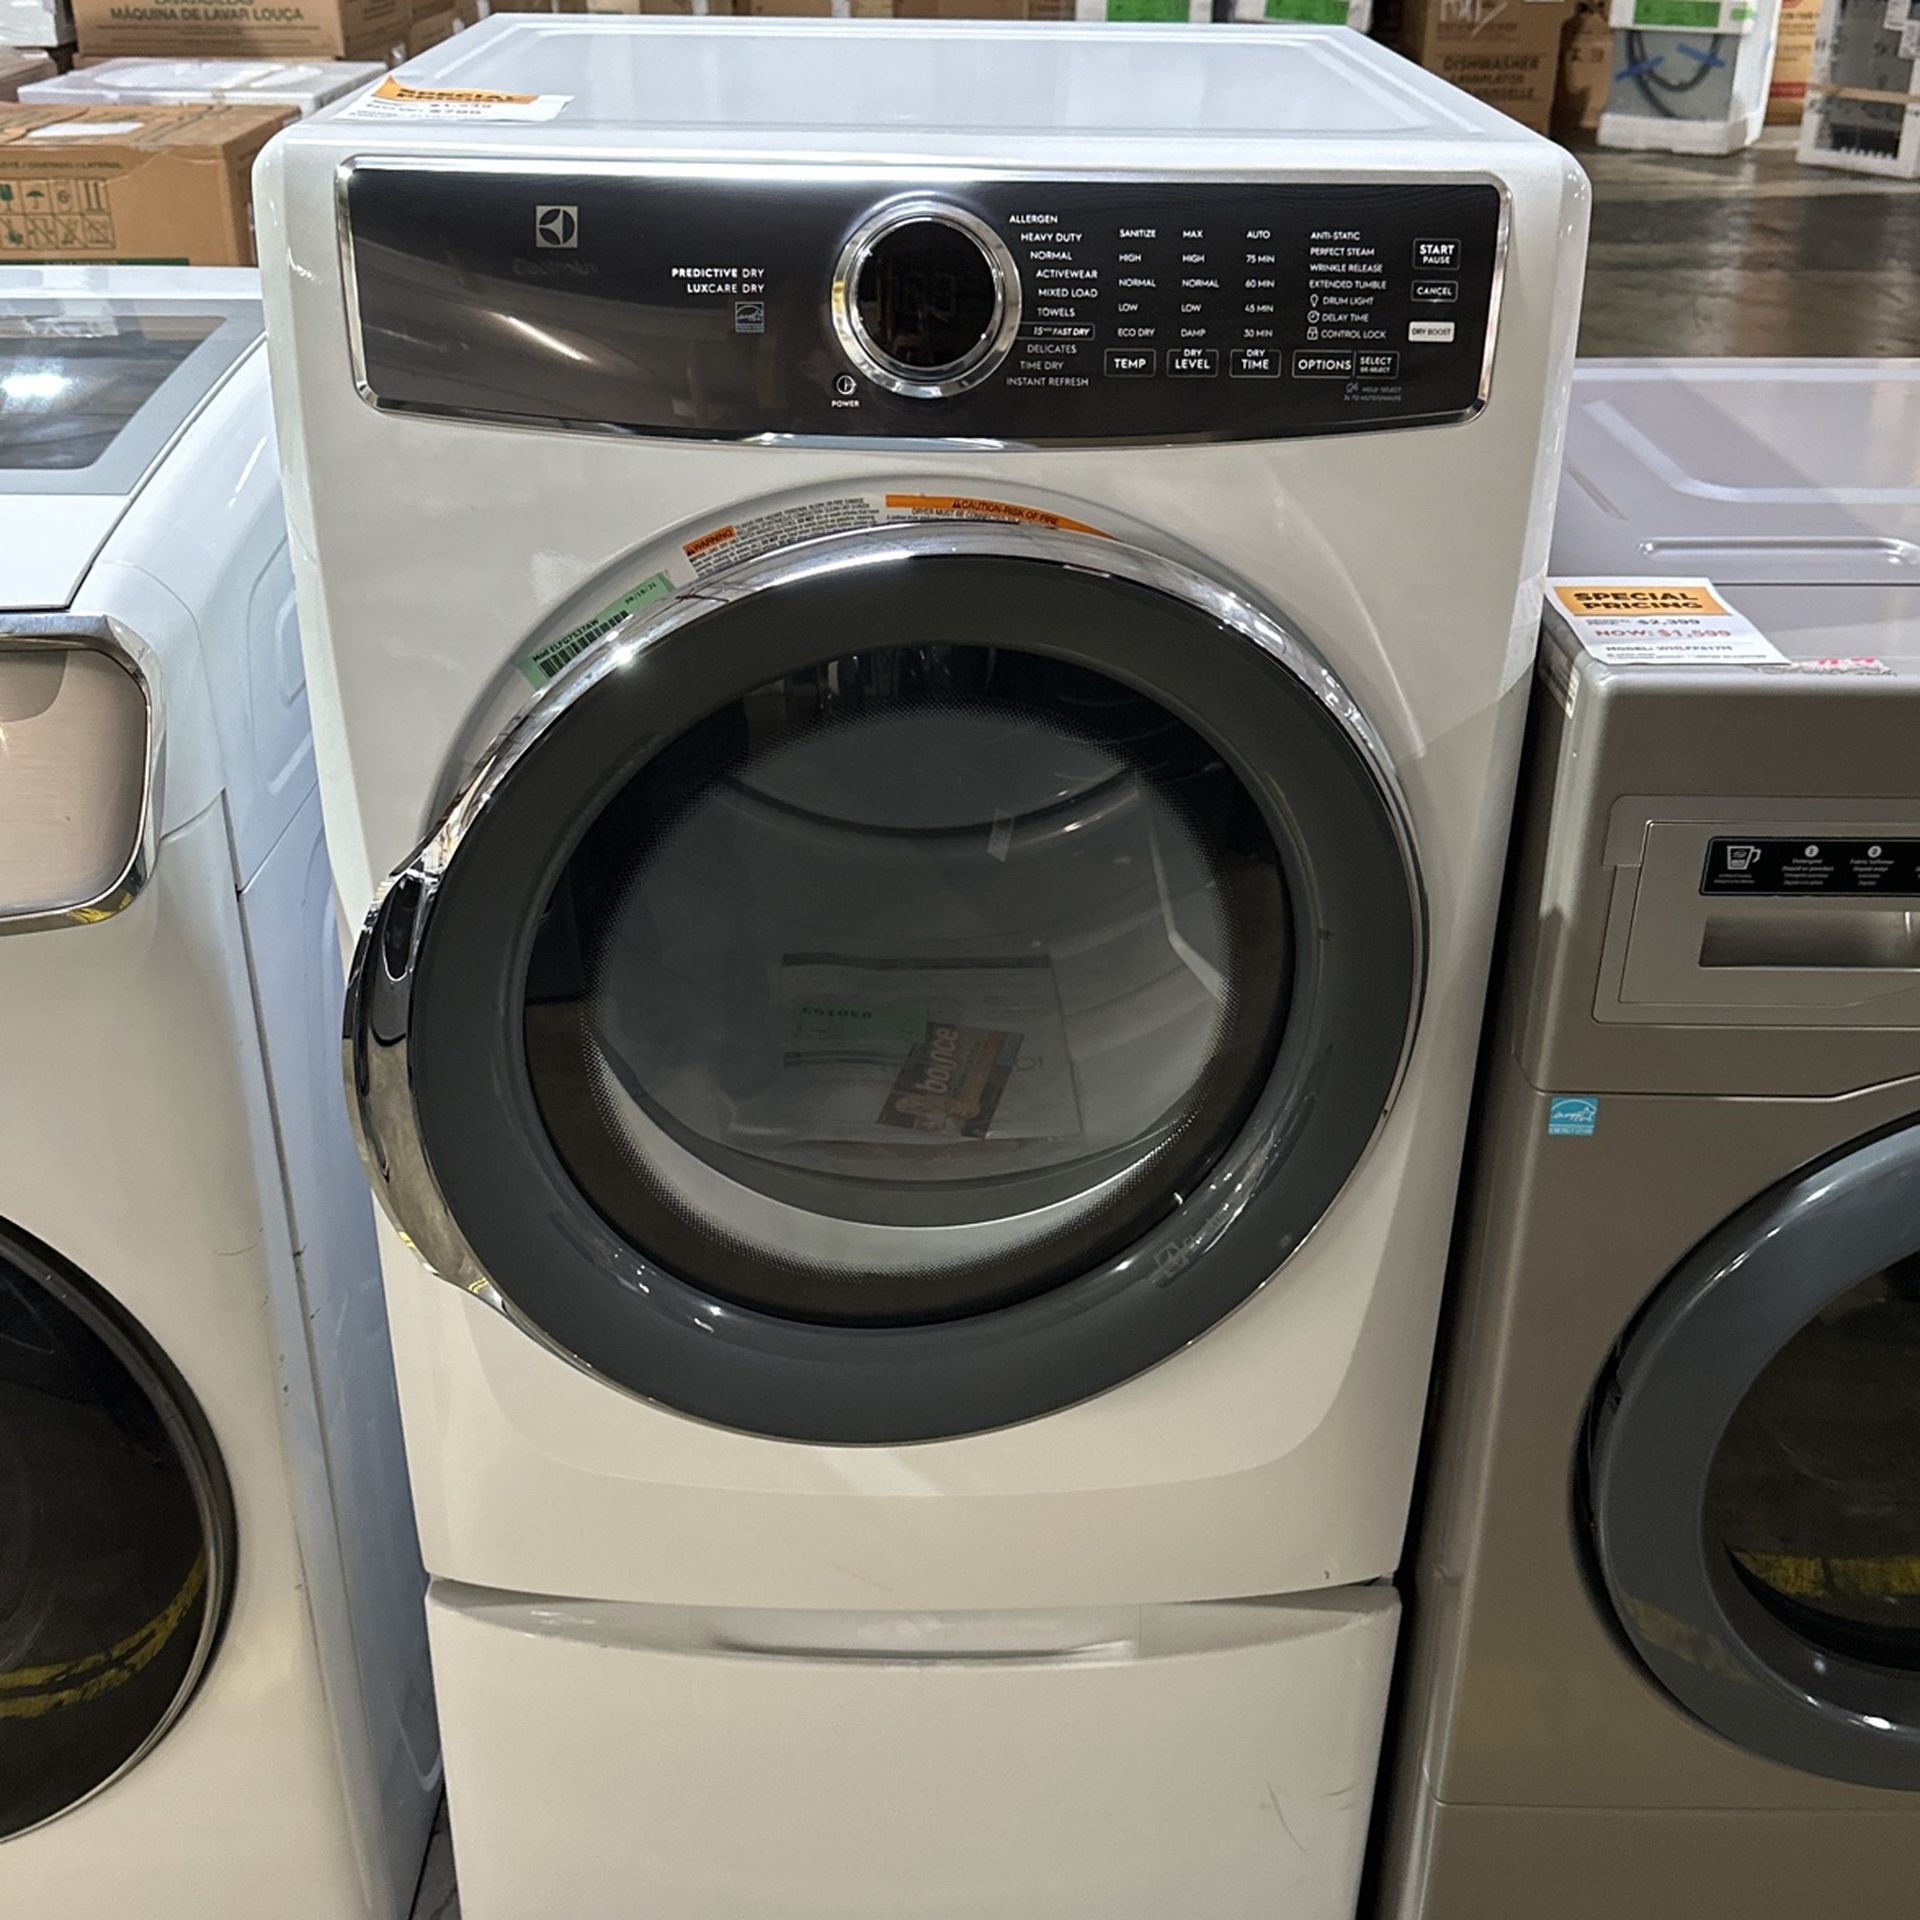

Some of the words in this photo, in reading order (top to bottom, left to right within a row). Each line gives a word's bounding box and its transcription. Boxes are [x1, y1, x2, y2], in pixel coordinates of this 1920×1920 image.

[110, 6, 177, 21] MÁQUINA
[181, 8, 199, 20] DE
[204, 8, 249, 20] LAVAR
[253, 8, 303, 22] LOUÇA
[1443, 55, 1539, 70] DISHWASHER
[1009, 215, 1058, 224] ALLERGEN
[1020, 233, 1053, 242] HEAVY
[1055, 233, 1083, 243] DUTY
[1119, 229, 1157, 238] SANITIZE
[1182, 229, 1203, 238] MAX
[1246, 230, 1271, 239] AUTO
[1310, 231, 1361, 241] ANTI-STATIC
[1310, 247, 1344, 257] PERFECT
[1346, 247, 1375, 256] STEAM
[1419, 244, 1455, 255] START
[1030, 251, 1072, 261] NORMAL
[1118, 254, 1142, 263] HIGH
[1182, 254, 1205, 263] HIGH
[1246, 254, 1257, 263] 75
[1258, 255, 1275, 263] MIN
[1422, 256, 1450, 265] PAUSE
[671, 268, 738, 278] PREDICTIVE
[742, 268, 765, 278] DRY
[1310, 264, 1346, 273] WRINKLE
[1348, 264, 1382, 273] RELEASE
[1036, 269, 1098, 279] ACTIVEWEAR
[1119, 278, 1156, 288] NORMAL
[1182, 278, 1220, 288] NORMAL
[1245, 279, 1257, 288] 60
[1258, 279, 1275, 288] MIN
[1309, 280, 1353, 289] EXTENDED
[1355, 280, 1387, 290] TUMBLE
[687, 284, 738, 293] LUXCARE
[742, 284, 765, 293] DRY
[1038, 288, 1069, 298] MIXED
[1071, 288, 1098, 298] LOAD
[1416, 286, 1452, 296] CANCEL
[1322, 296, 1348, 305] DRUM
[1350, 296, 1374, 306] LIGHT
[1037, 307, 1075, 317] TOWELS
[1118, 303, 1138, 312] LOW
[1181, 303, 1201, 312] LOW
[1245, 304, 1256, 313] 45
[1257, 304, 1274, 313] MIN
[1322, 313, 1348, 322] DELAY
[1350, 313, 1369, 322] TIME
[1052, 327, 1073, 336] FAST
[1073, 327, 1091, 336] DRY
[1117, 328, 1137, 337] ECO
[1138, 328, 1156, 337] DRY
[1180, 328, 1206, 338] DAMP
[1256, 329, 1273, 338] MIN
[1321, 329, 1361, 339] CONTROL
[1363, 329, 1386, 339] LOCK
[1412, 328, 1426, 336] DRY
[1427, 328, 1451, 336] BOOST
[1027, 344, 1078, 354] DELICATES
[1183, 349, 1203, 357] DRY
[1246, 349, 1265, 357] DRY
[1020, 360, 1043, 370] TIME
[1044, 361, 1064, 370] DRY
[1114, 358, 1147, 369] TEMP
[1175, 358, 1210, 369] LEVEL
[1241, 359, 1270, 370] TIME
[1298, 359, 1351, 370] OPTIONS
[1360, 357, 1392, 365] SELECT
[1006, 377, 1046, 387] INSTANT
[1048, 377, 1089, 387] REFRESH
[831, 400, 860, 408] POWER
[1040, 514, 1059, 525] FIRE
[693, 530, 734, 550] WARNING
[1573, 592, 1700, 601] SPECIAL
[1595, 629, 1653, 637] NOW:
[1657, 629, 1732, 638] $1,599
[916, 1028, 959, 1095] bounce
